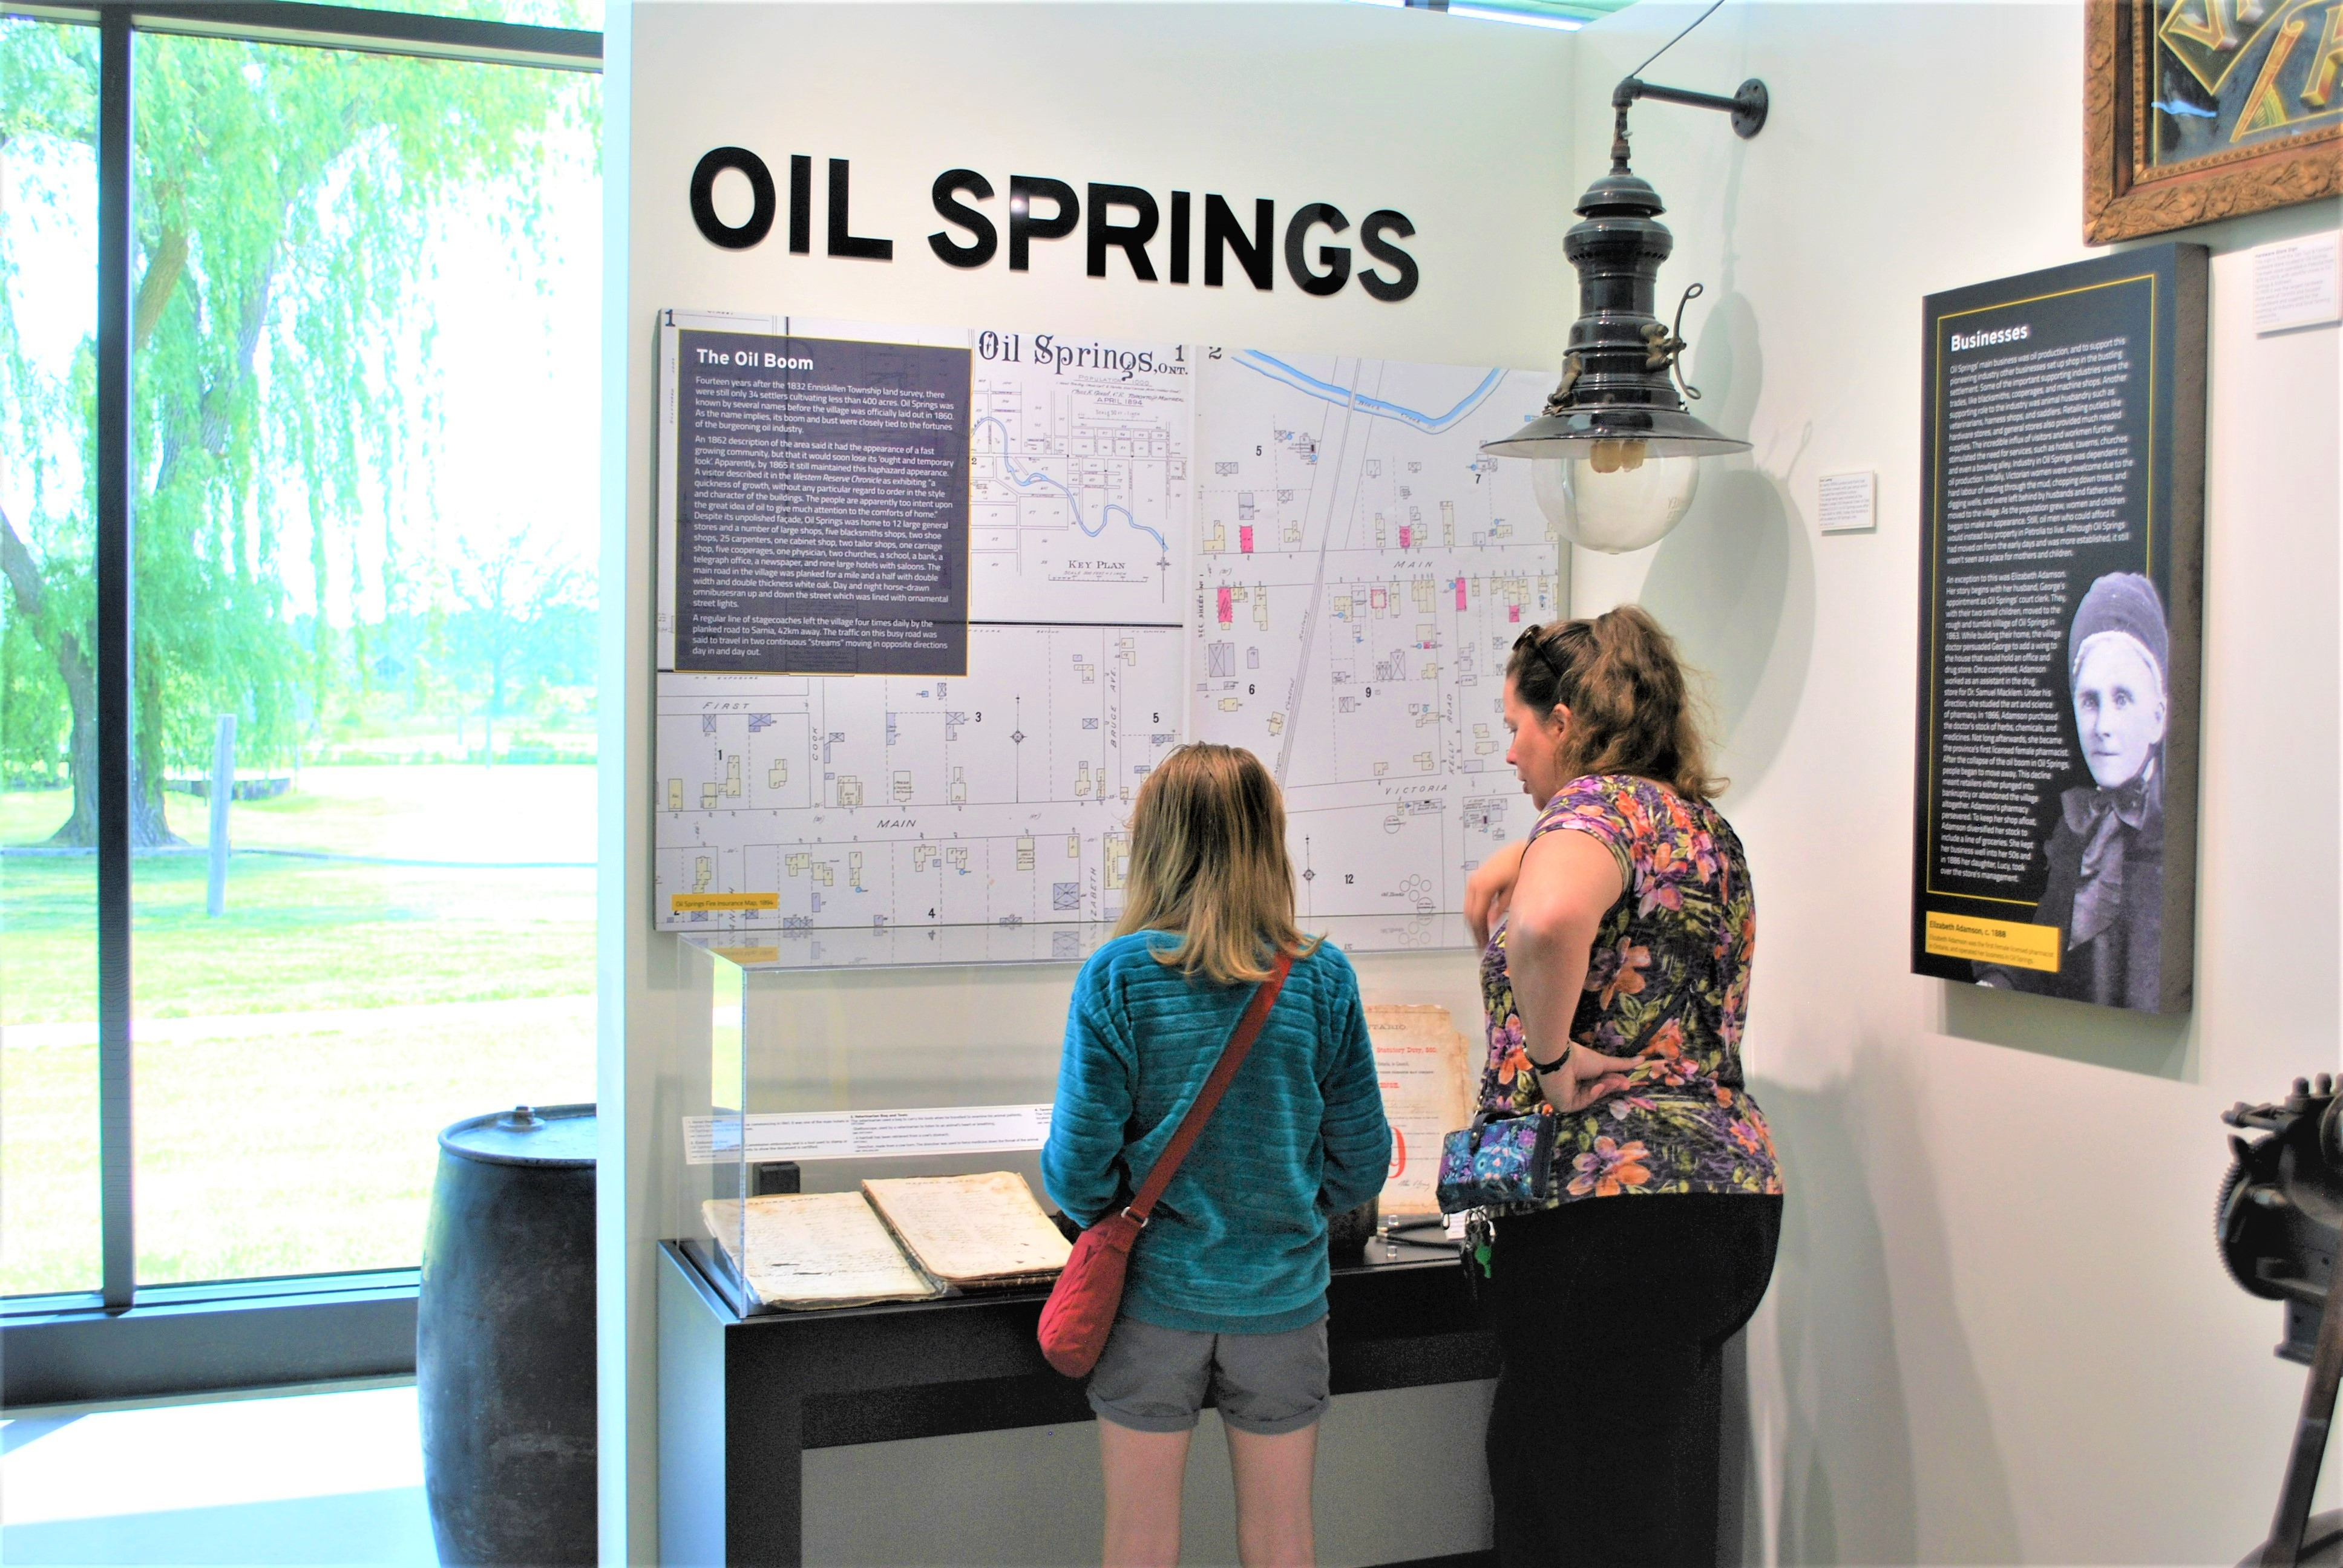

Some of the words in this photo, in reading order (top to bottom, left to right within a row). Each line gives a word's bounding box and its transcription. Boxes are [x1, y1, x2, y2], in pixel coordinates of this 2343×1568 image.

[690, 146, 894, 261] OIL
[926, 168, 1420, 302] SPRINGS
[665, 309, 675, 327] 1
[1951, 324, 2028, 351] Businesses
[979, 330, 1021, 362] Oil
[696, 348, 730, 365] The
[735, 351, 759, 367] Oil
[764, 353, 814, 371] Boom
[1175, 345, 1185, 362] 1
[1208, 346, 1222, 361] 2
[1078, 374, 1122, 384] POPULATION
[696, 377, 730, 387] Fourteen
[731, 381, 751, 390] years
[753, 380, 771, 388] after
[772, 381, 784, 390] the
[787, 382, 805, 391] 1832
[807, 383, 846, 393] Enniskillen
[847, 385, 881, 397] Township
[882, 387, 898, 396] land
[899, 390, 924, 399] survey,
[926, 390, 945, 398] there
[716, 389, 729, 397] still
[730, 390, 747, 400] only
[759, 391, 788, 400] settlers
[789, 393, 827, 405] cultivating
[828, 395, 843, 403] less
[844, 396, 860, 404] than
[862, 397, 877, 405] 400
[900, 399, 910, 407] Oil
[911, 399, 938, 411] Springs
[695, 399, 720, 407] known
[722, 400, 731, 410] by
[733, 400, 759, 410] several
[787, 403, 811, 412] before
[825, 405, 850, 416] village
[867, 408, 897, 419] officially
[934, 411, 954, 420] 1860.
[706, 410, 719, 418] the
[743, 411, 771, 423] implies,
[784, 414, 805, 422] boom
[821, 416, 837, 424] bust
[858, 417, 883, 428] closely
[885, 419, 899, 427] tied
[909, 420, 921, 428] the
[922, 420, 952, 430] fortunes
[704, 420, 717, 428] the
[718, 421, 761, 433] burgeoning
[761, 423, 770, 431] oil
[772, 423, 804, 435] industry.
[1256, 445, 1262, 457] 5
[1475, 474, 1481, 485] 7
[1068, 560, 1092, 569] KEY
[1096, 561, 1126, 569] PLAN
[1394, 560, 1434, 569] MAIN
[700, 614, 726, 624] regular
[752, 615, 802, 626] stagecoaches
[830, 617, 853, 627] village
[893, 619, 909, 629] daily
[911, 619, 919, 629] by
[692, 646, 706, 656] day
[731, 647, 745, 657] day
[1248, 684, 1255, 696] 6
[1366, 687, 1372, 699] 9
[703, 702, 750, 711] FIRST
[975, 711, 982, 723] 3
[1153, 713, 1159, 724] 5
[717, 750, 723, 760] 1
[1385, 784, 1447, 795] VICTORIA
[877, 819, 917, 829] MAIN
[1345, 874, 1354, 885] 12
[928, 907, 936, 918] 4
[1929, 921, 1955, 932] Elizabeth
